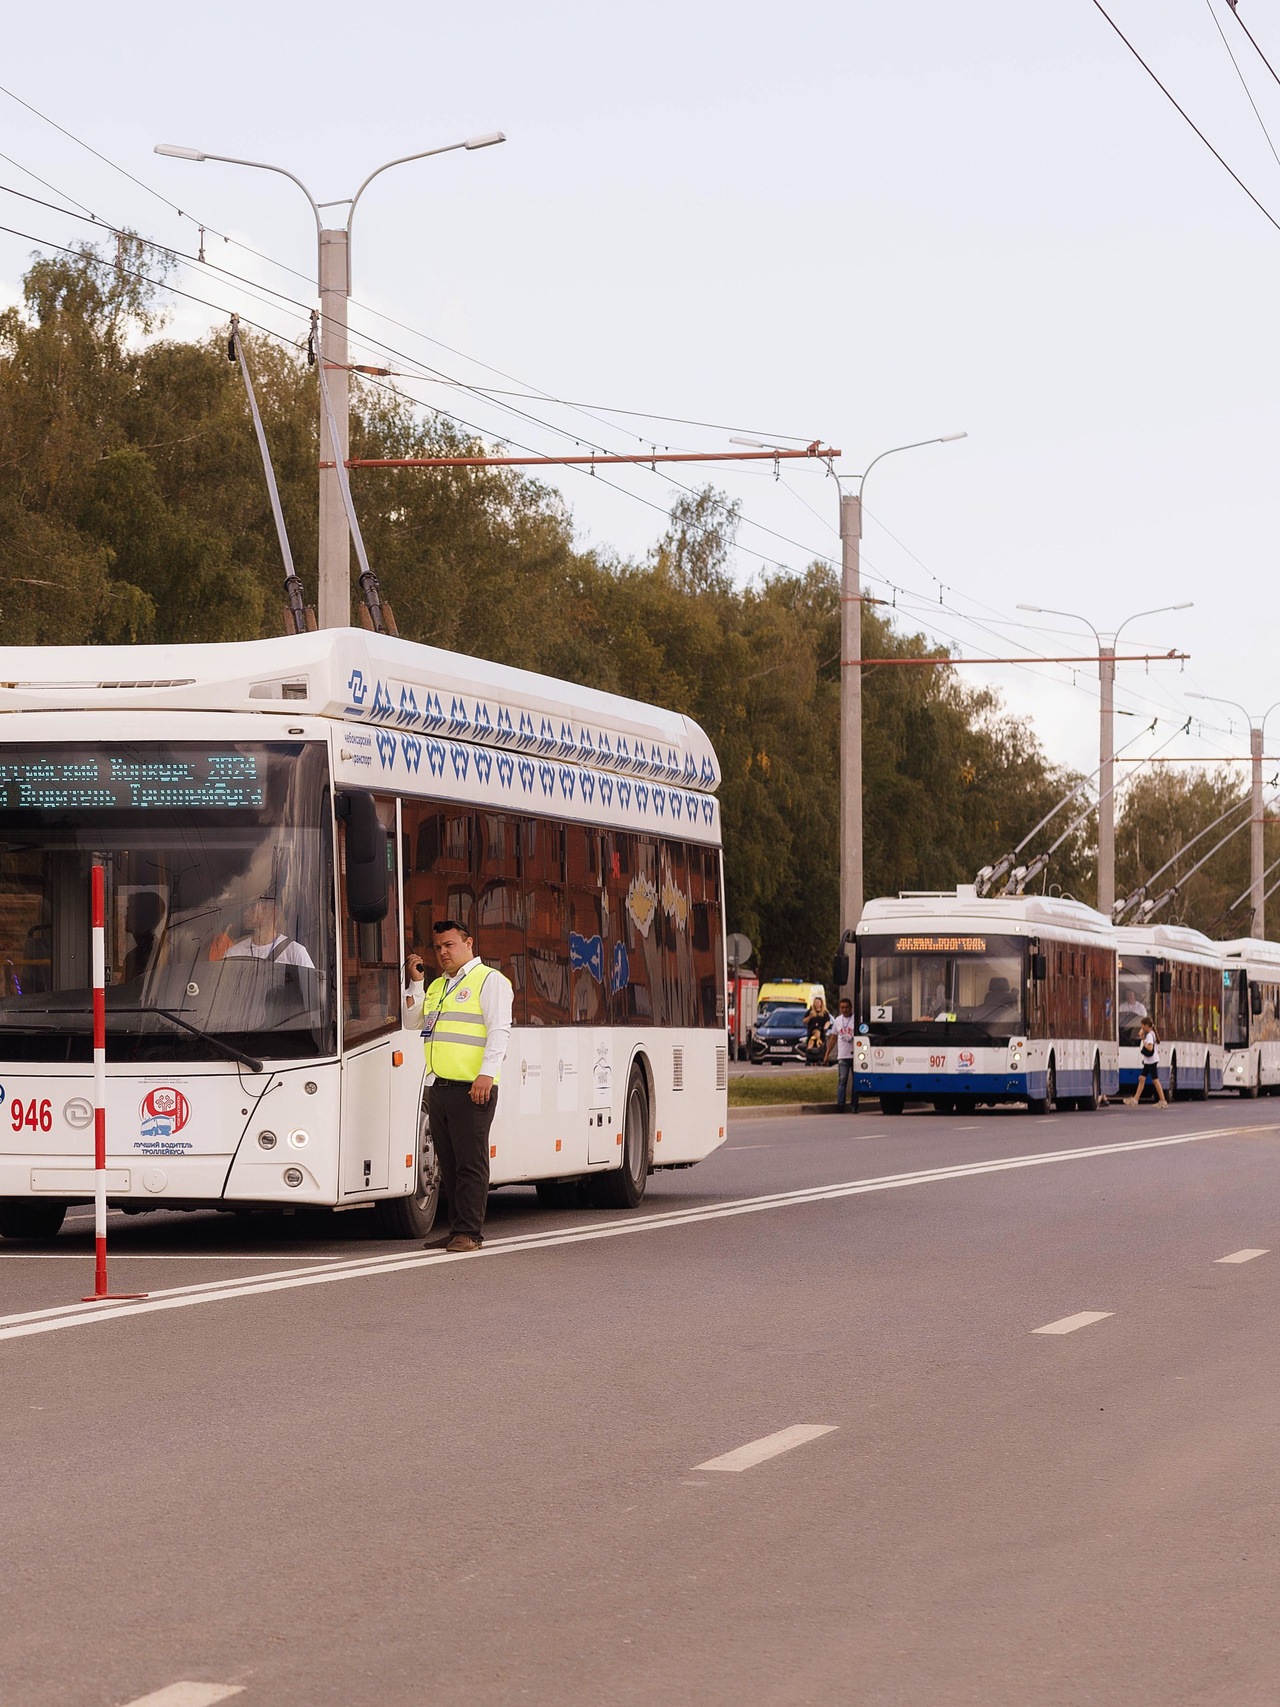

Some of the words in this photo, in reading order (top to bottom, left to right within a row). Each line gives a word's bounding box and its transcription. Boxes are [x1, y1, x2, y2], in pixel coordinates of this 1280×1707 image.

[344, 731, 372, 747] чебоксарский
[208, 757, 257, 780] 2024
[352, 754, 372, 768] ранспорт
[877, 1008, 886, 1019] 2
[929, 1055, 946, 1068] 907
[11, 1098, 53, 1132] 946
